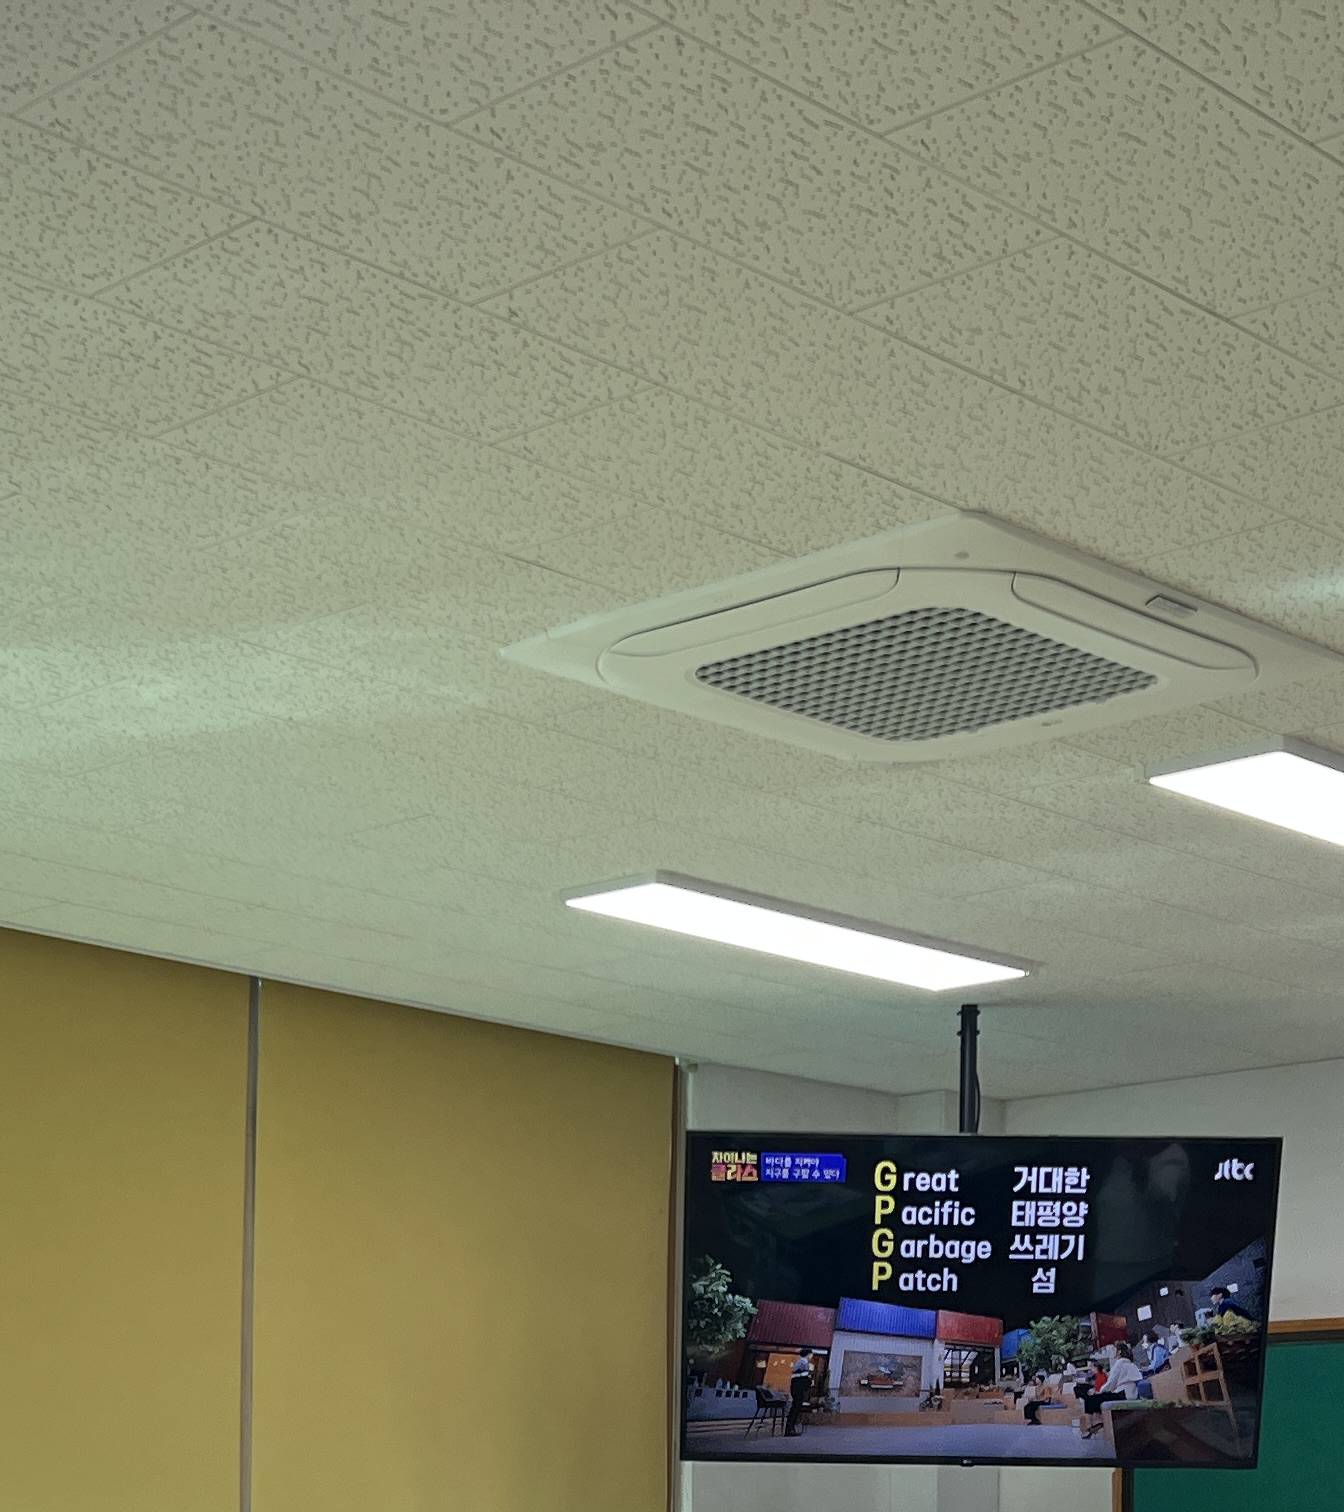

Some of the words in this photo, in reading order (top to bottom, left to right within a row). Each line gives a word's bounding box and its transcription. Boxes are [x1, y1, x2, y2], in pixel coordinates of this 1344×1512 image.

[1012, 1166, 1090, 1194] 거대한
[1011, 1200, 1089, 1228] 태평양
[1008, 1234, 1085, 1261] 쓰레기
[1031, 1267, 1057, 1294] 섬
